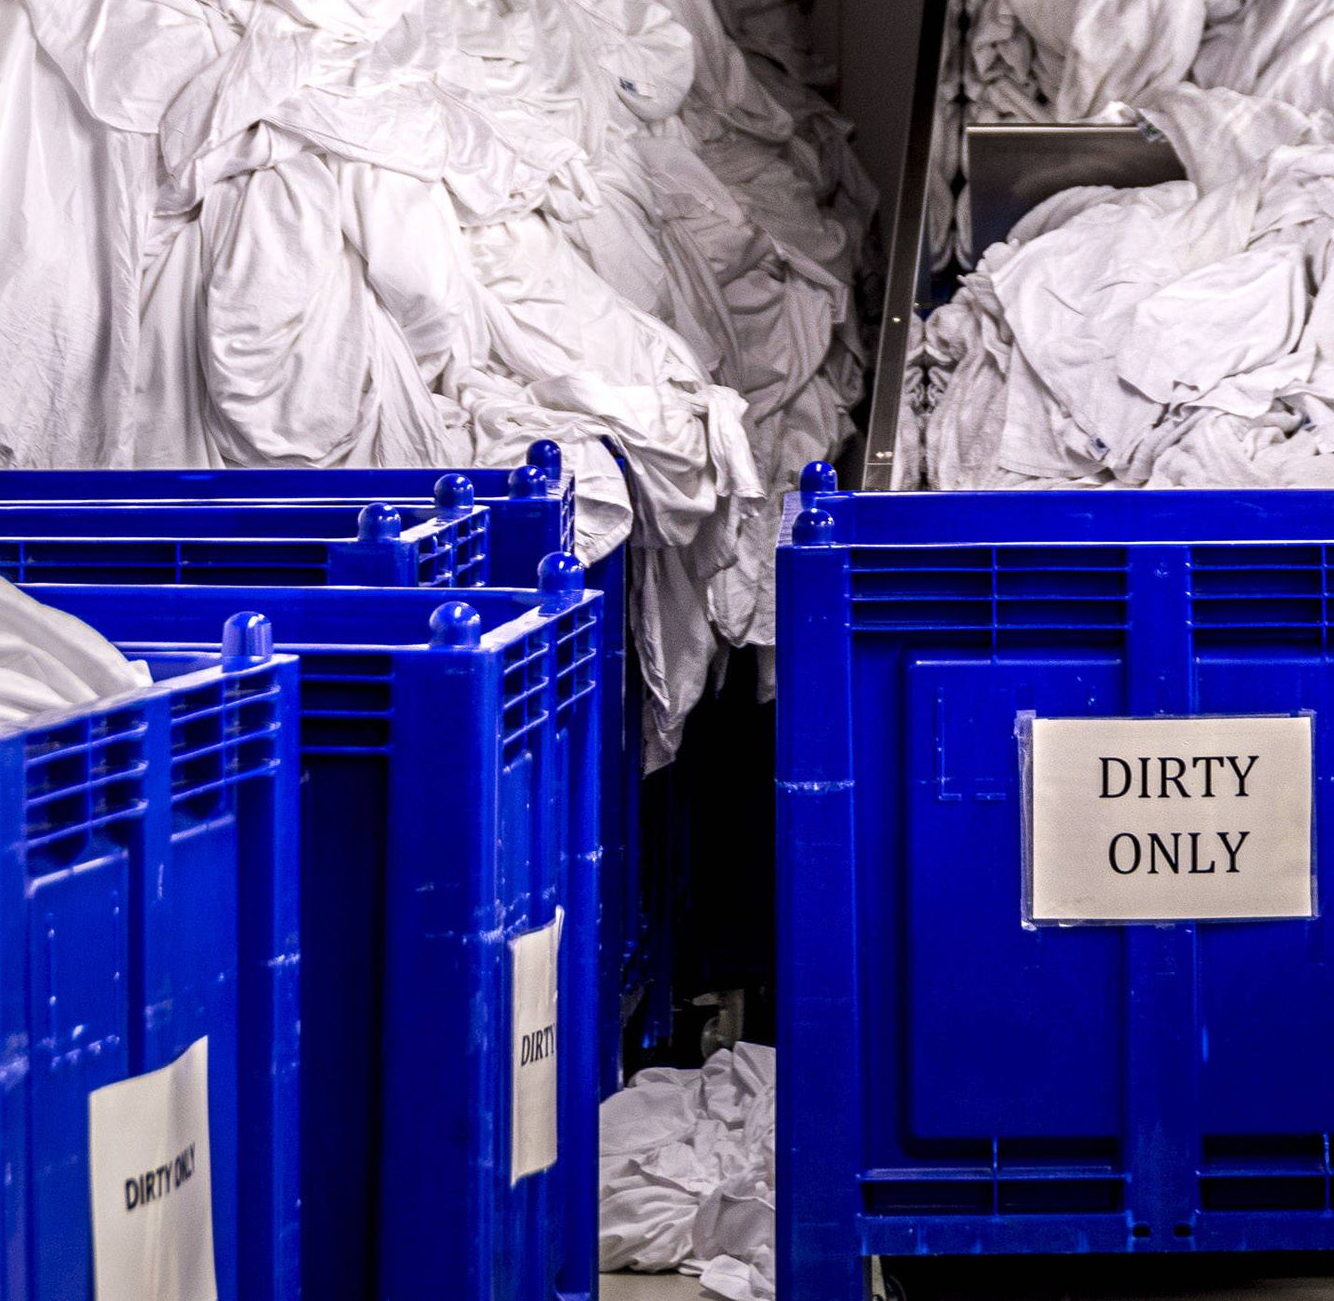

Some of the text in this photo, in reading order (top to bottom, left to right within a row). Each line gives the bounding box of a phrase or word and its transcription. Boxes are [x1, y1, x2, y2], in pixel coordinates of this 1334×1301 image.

[1098, 755, 1260, 798] DIRTY
[1108, 831, 1251, 875] ONLY
[125, 1141, 196, 1211] DIRTY ONLY
